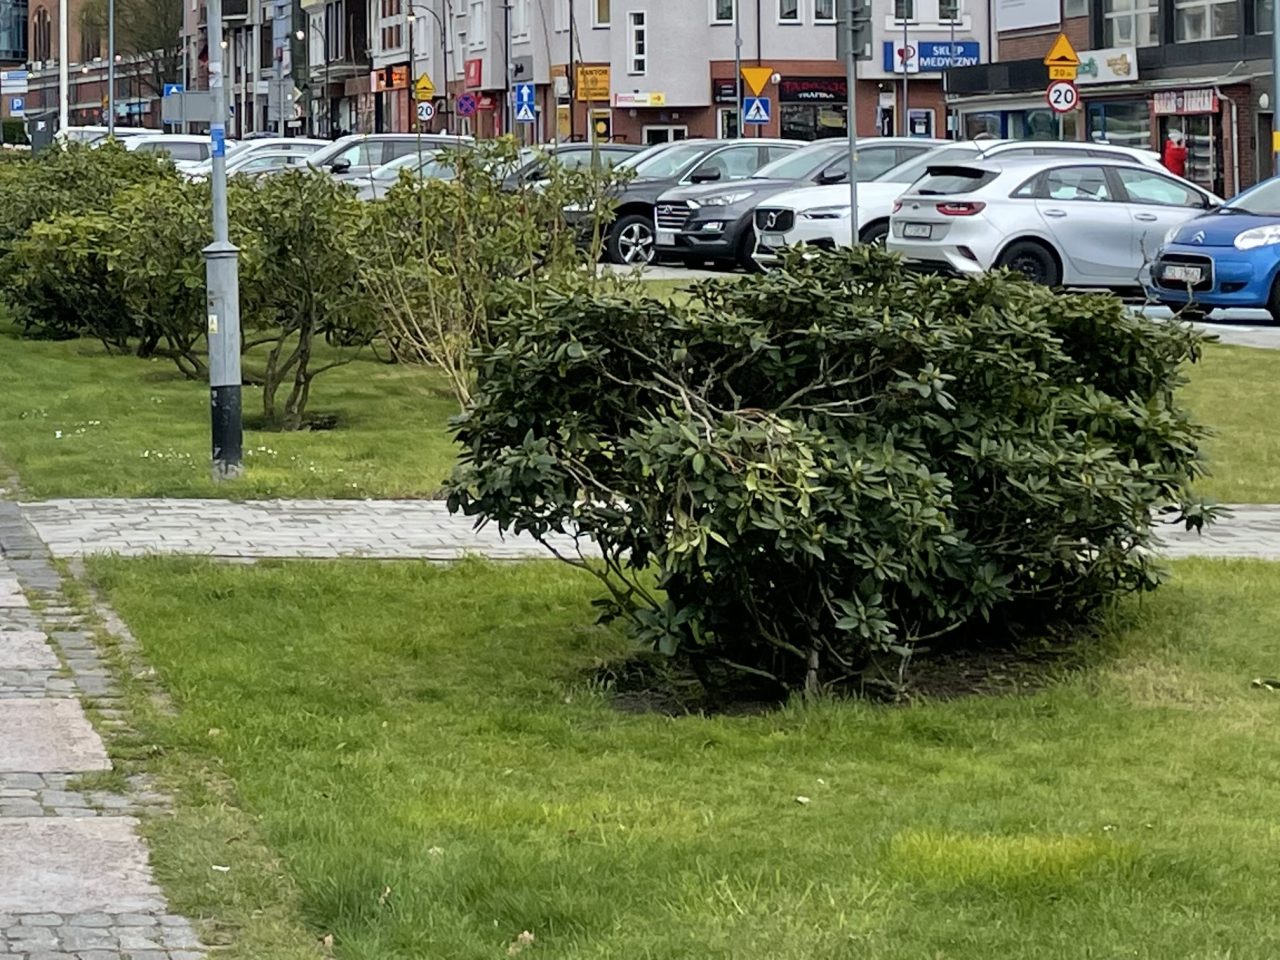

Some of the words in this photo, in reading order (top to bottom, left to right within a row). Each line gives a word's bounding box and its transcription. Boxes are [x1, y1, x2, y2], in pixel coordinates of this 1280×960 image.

[932, 46, 964, 56] SKLP
[1053, 89, 1073, 104] 20
[13, 99, 22, 109] P
[418, 106, 433, 117] 20
